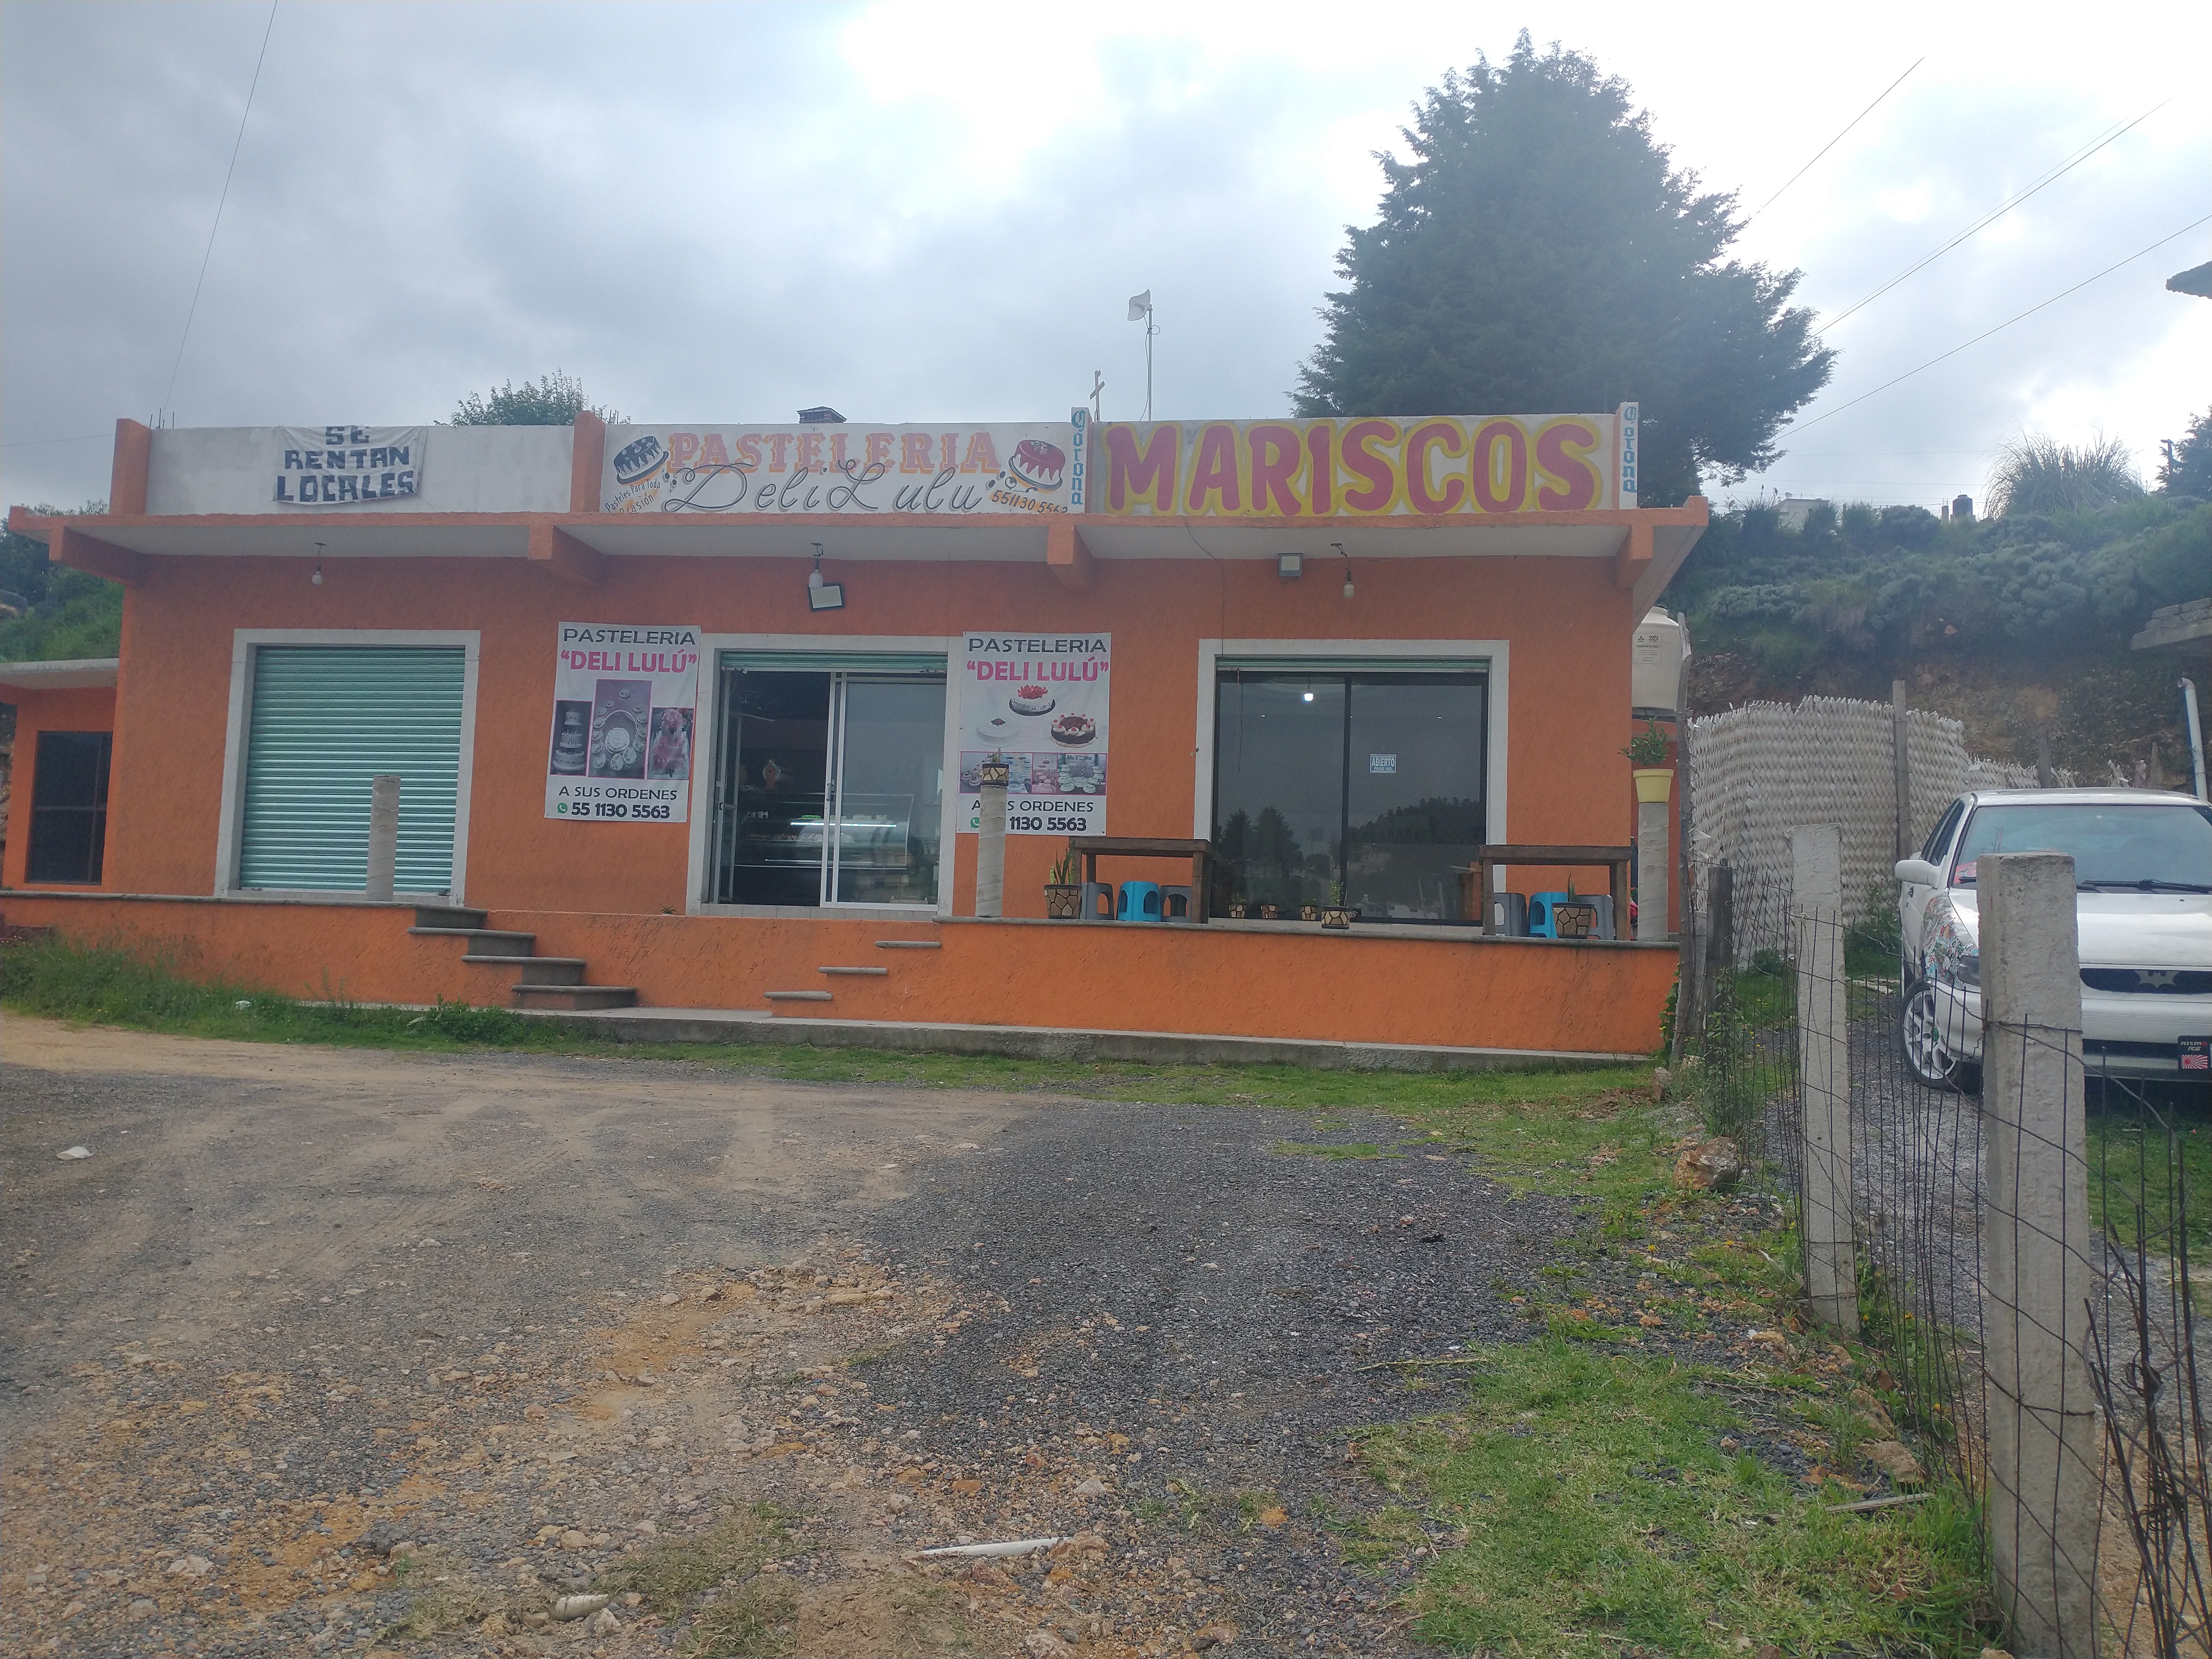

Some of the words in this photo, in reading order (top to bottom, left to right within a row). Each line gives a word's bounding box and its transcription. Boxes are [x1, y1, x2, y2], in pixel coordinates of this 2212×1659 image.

[325, 426, 369, 445] SE
[285, 445, 409, 469] RENTAN
[667, 432, 1002, 474] PASTELERIA
[1071, 409, 1086, 505] Corona
[1622, 406, 1637, 493] Corona
[1103, 418, 1601, 517] MARISCOS
[276, 470, 414, 502] LOCALES
[605, 490, 631, 512] Pasteles
[630, 483, 645, 494] Para
[647, 479, 661, 489] Toda
[563, 628, 696, 645] PASTELERIA
[969, 638, 1107, 653] PASTELERIA
[1371, 757, 1395, 767] ABIERTO
[558, 786, 570, 796] A
[574, 787, 601, 798] SUS
[605, 788, 678, 800] ORDENES
[571, 802, 590, 816] 55
[595, 803, 627, 817] 1130
[631, 805, 670, 819] 5563
[1020, 801, 1094, 812] ORDENES
[1009, 816, 1043, 830] 1130
[1046, 817, 1086, 831] 5563
